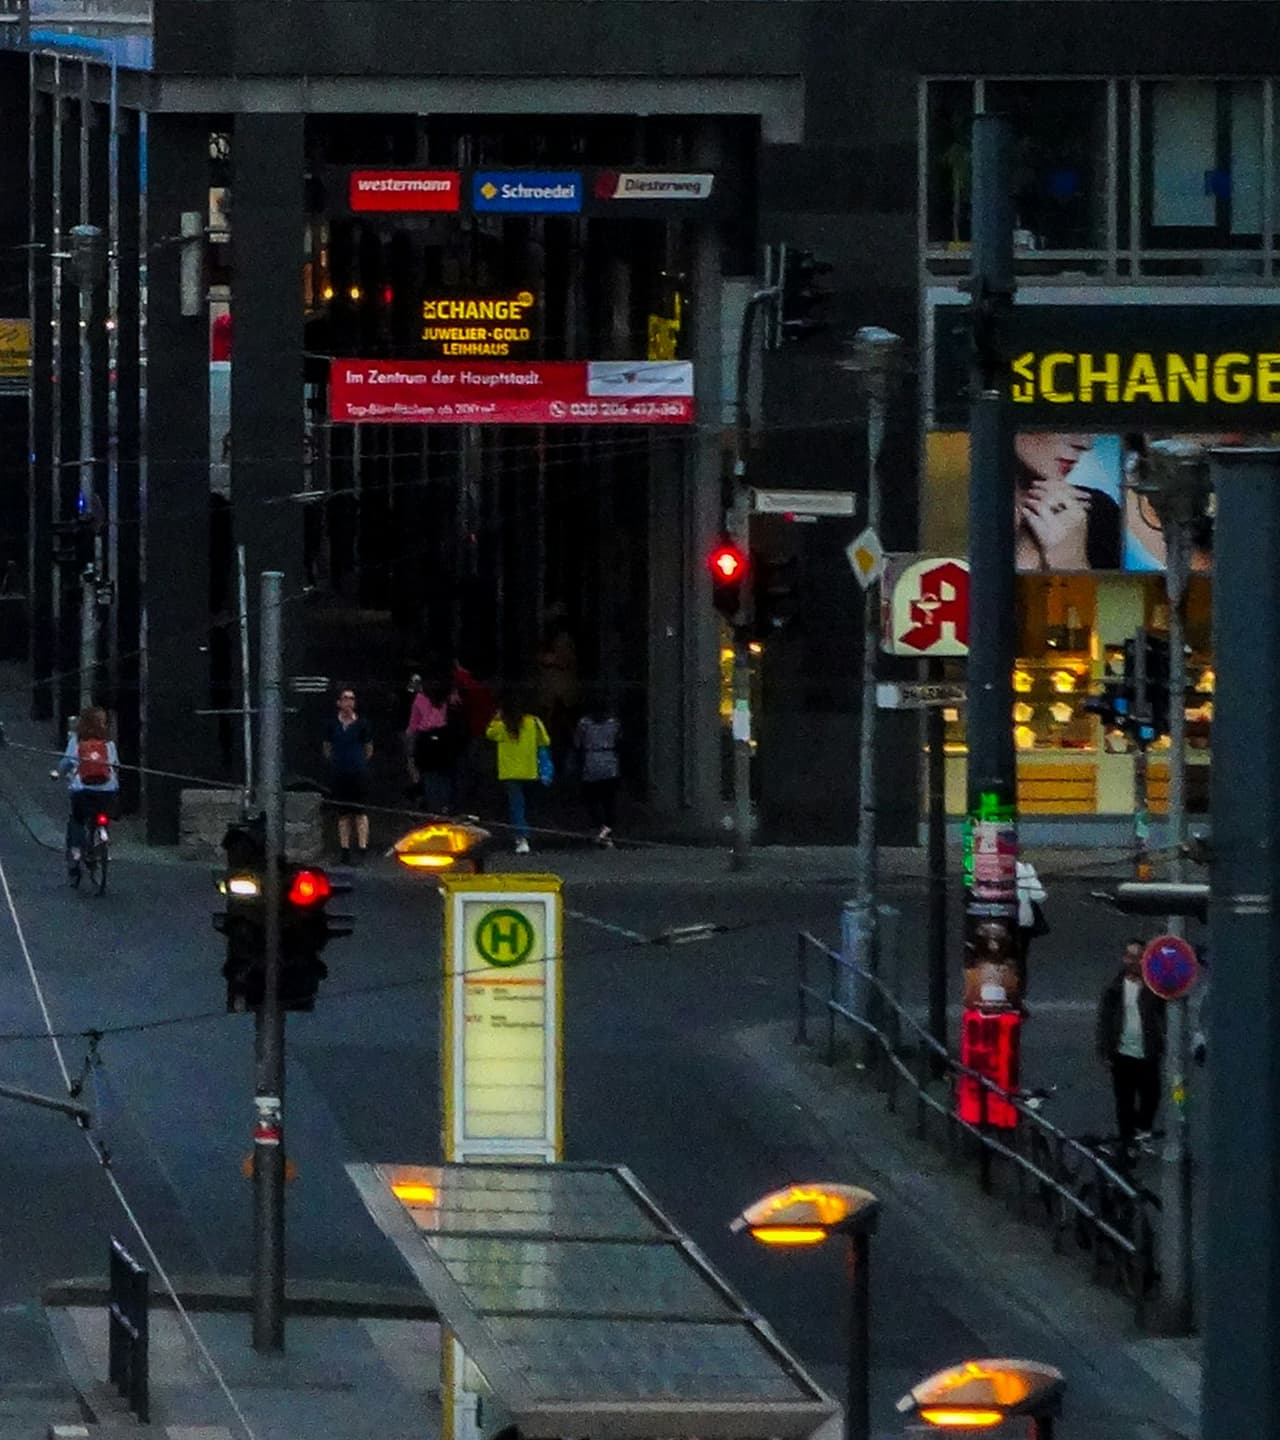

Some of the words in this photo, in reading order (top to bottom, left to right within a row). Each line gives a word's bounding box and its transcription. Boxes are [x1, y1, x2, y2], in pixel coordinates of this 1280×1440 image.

[357, 177, 452, 193] westermann
[624, 178, 702, 196] Diesterweg
[441, 342, 510, 357] LEIHHAUS
[346, 370, 364, 384] Im
[367, 370, 426, 384] Zentrum
[431, 369, 456, 384] der
